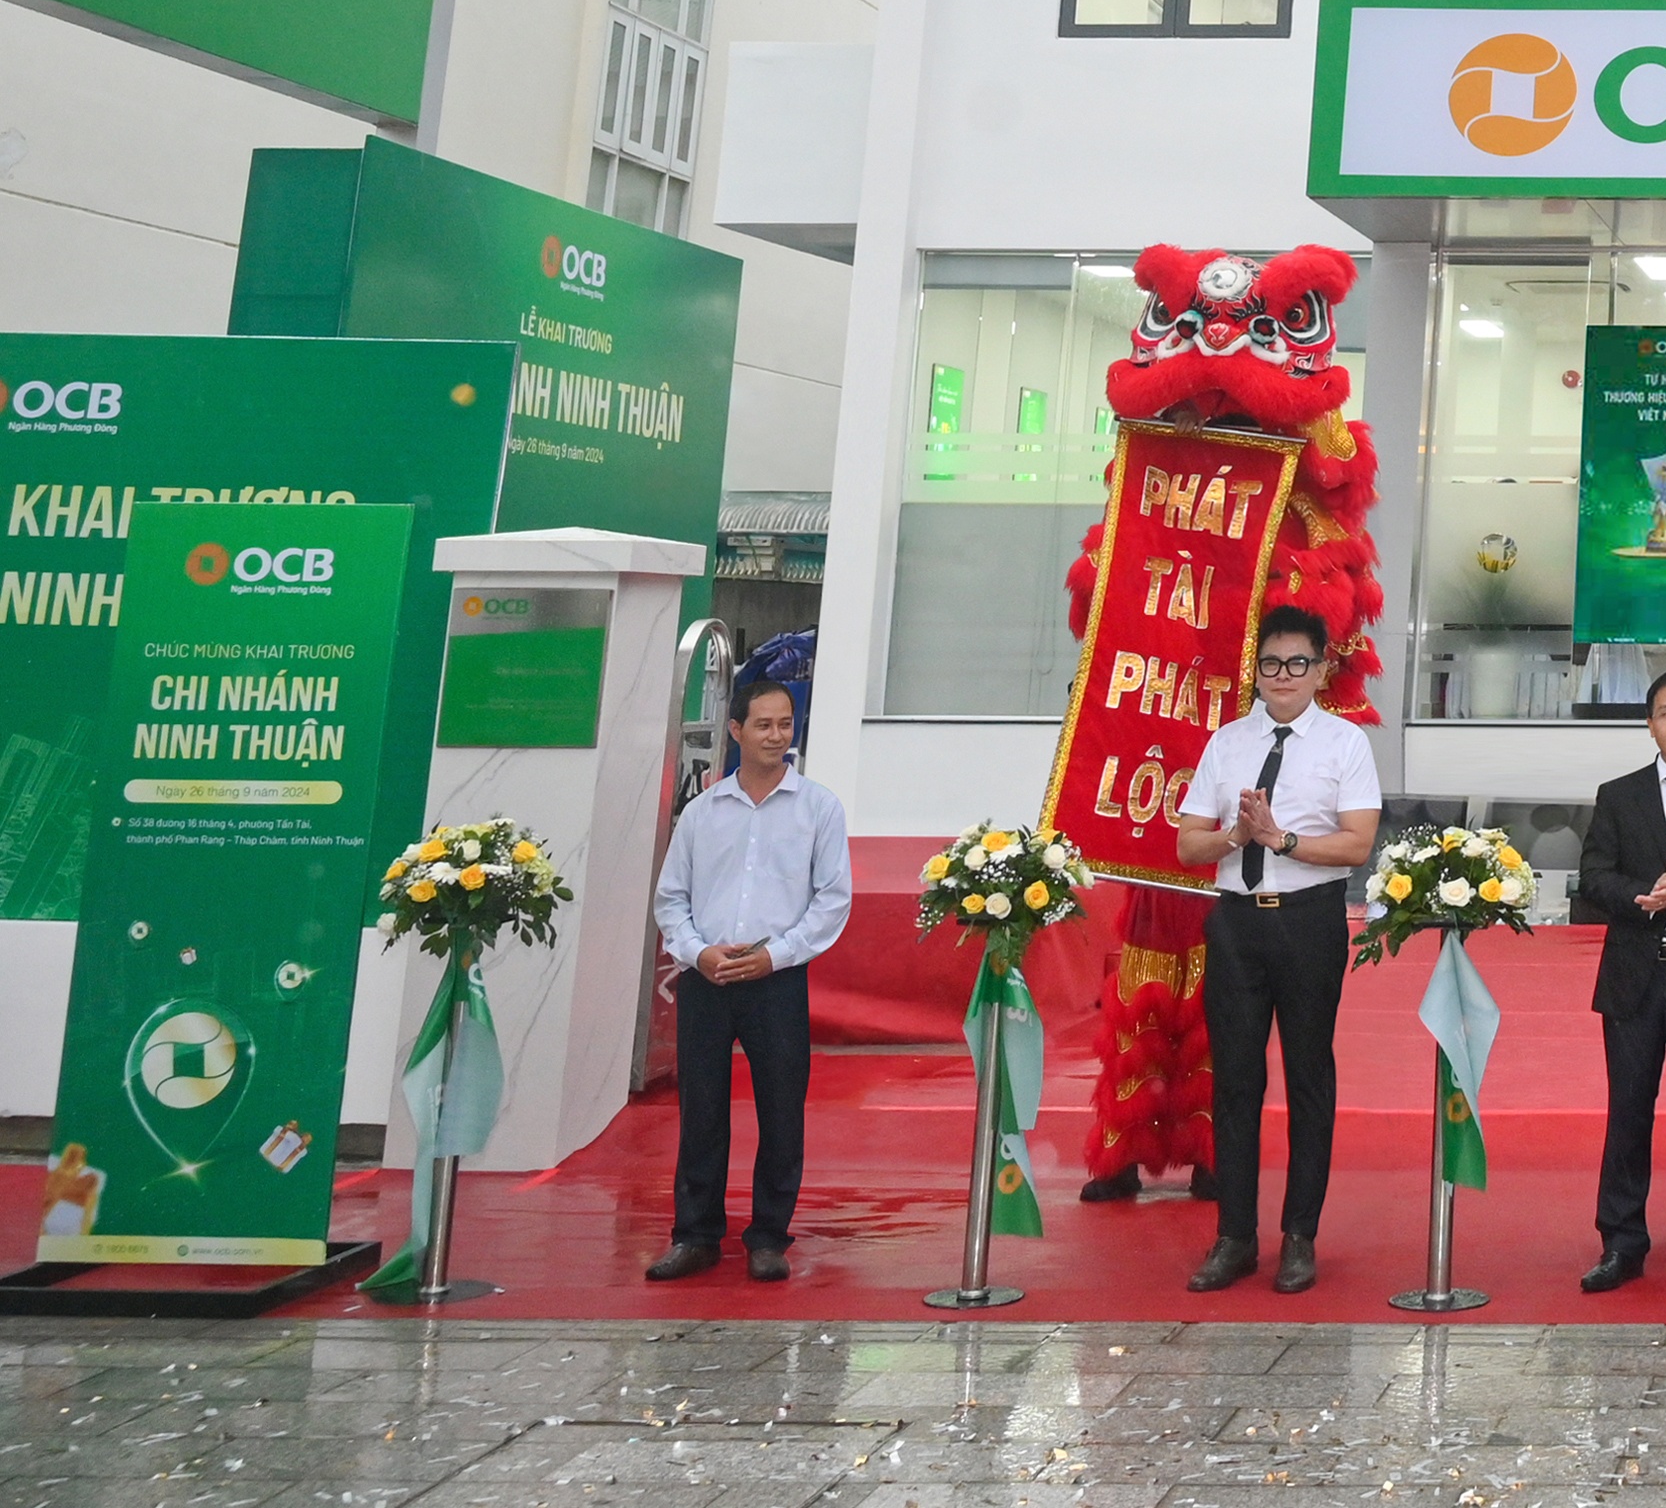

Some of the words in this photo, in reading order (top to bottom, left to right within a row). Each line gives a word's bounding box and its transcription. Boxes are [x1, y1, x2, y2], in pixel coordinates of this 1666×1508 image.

[562, 245, 607, 287] OCB
[520, 305, 536, 336] LỄ
[537, 317, 566, 344] KHAI
[568, 322, 613, 354] TRƯƠNG
[13, 380, 122, 419] OCB
[512, 361, 552, 419] NH
[556, 370, 612, 430] NINH
[617, 382, 684, 450] THUẬN
[527, 437, 537, 453] 26
[561, 444, 567, 459] 9
[585, 448, 604, 463] 2024
[8, 484, 135, 538] KHAI
[1139, 465, 1262, 540] PHÁT
[233, 547, 335, 582] OCB
[0, 571, 124, 627] NINH
[484, 598, 529, 614] OCB
[1143, 551, 1211, 630] TÀI
[144, 642, 190, 659] CHÚC
[194, 642, 241, 659] MỪNG
[245, 644, 283, 660] KHAI
[288, 643, 355, 660] TRƯƠNG
[151, 674, 207, 711] CHI
[217, 669, 338, 712] NHÁNH
[1104, 651, 1231, 733] PHÁT
[133, 723, 218, 760] NINH
[229, 718, 345, 767] THUẬN
[189, 785, 204, 797] 26
[243, 786, 250, 797] 9
[282, 786, 311, 798] 2024
